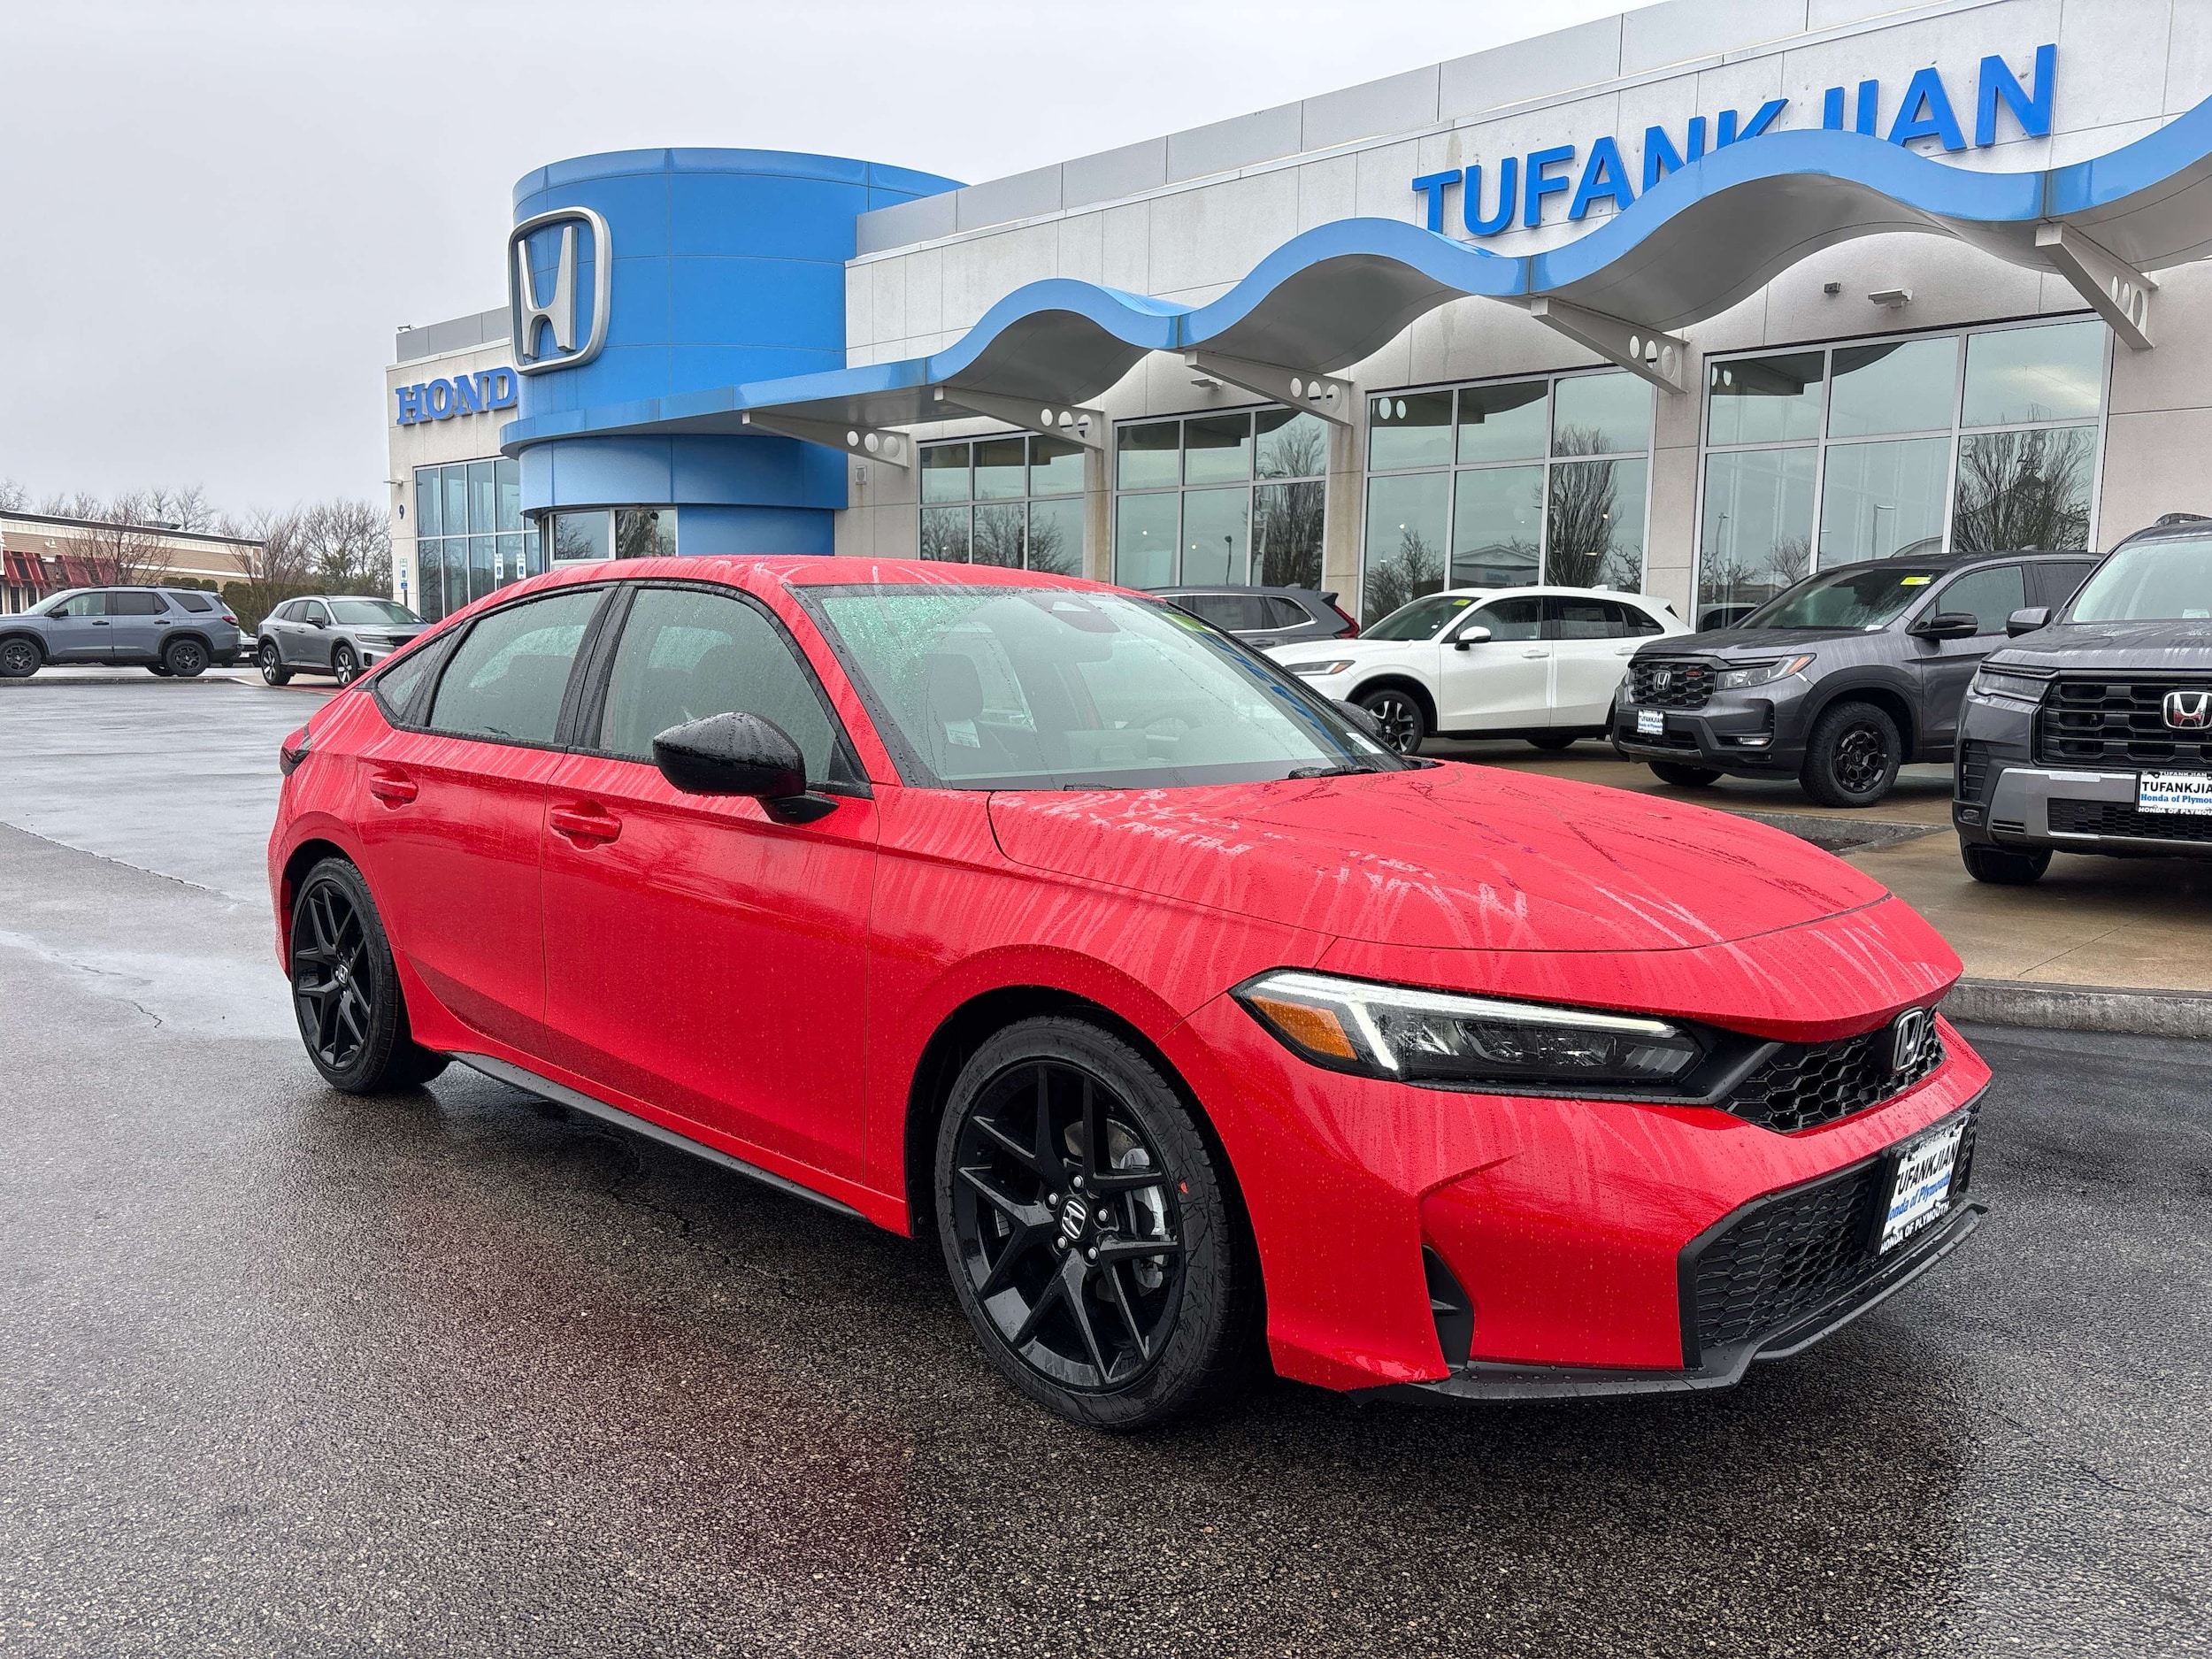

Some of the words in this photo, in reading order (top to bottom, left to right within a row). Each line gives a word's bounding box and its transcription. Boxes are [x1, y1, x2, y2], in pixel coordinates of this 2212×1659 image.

[395, 366, 518, 426] HOND
[399, 504, 404, 519] 9
[1896, 1140, 1959, 1195] UFANKJIAN
[1888, 1197, 1909, 1221] onda
[1909, 1189, 1920, 1208] of
[1917, 1170, 1951, 1203] Plymouth
[1879, 1229, 1903, 1256] HONDA
[1904, 1222, 1916, 1237] OF
[1915, 1201, 1950, 1232] PLYMOUTH
